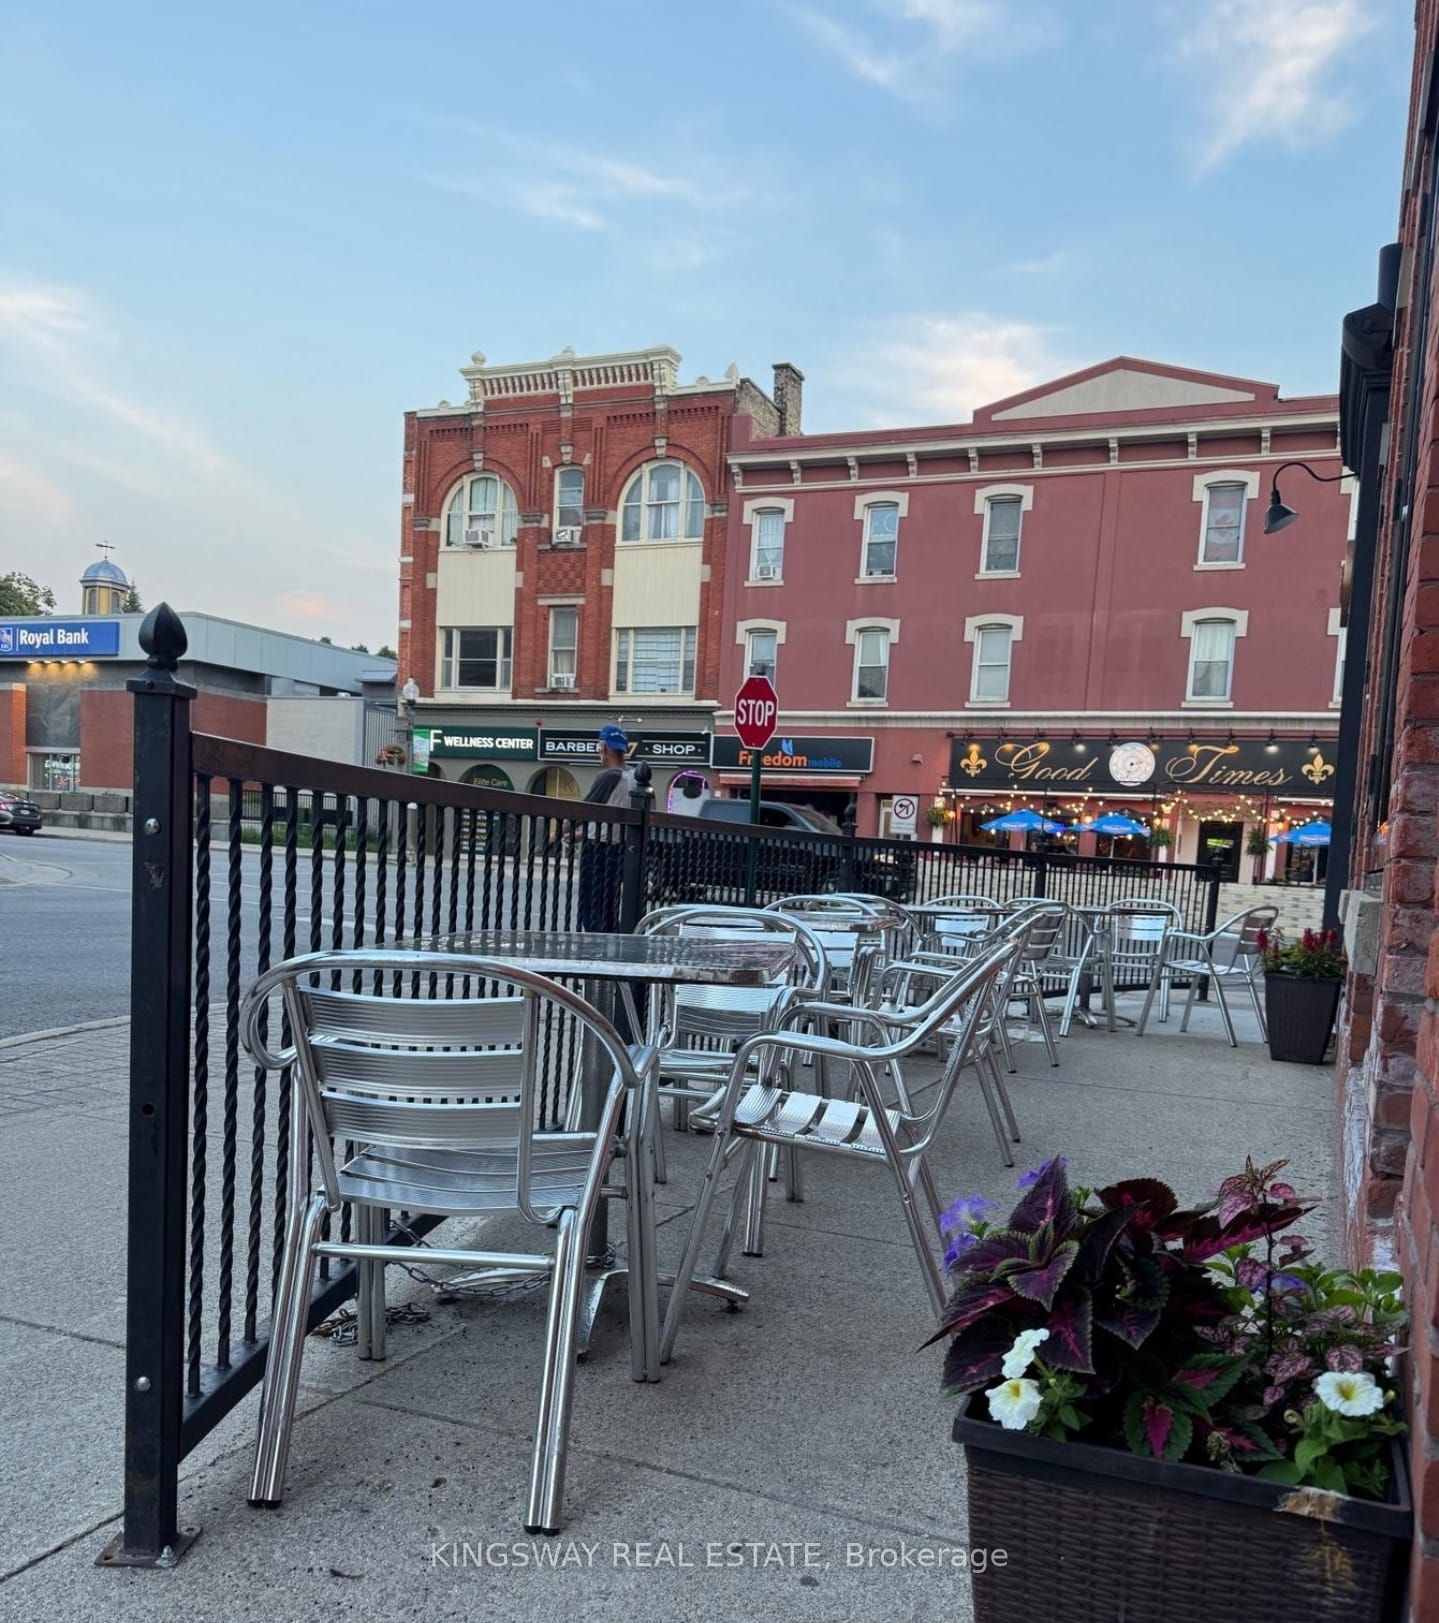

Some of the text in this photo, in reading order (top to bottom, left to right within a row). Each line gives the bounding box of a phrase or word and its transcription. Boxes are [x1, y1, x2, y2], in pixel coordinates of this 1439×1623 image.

[20, 628, 89, 649] Royal Bank
[737, 698, 775, 727] STOP
[443, 736, 494, 748] WELLNESS
[495, 738, 534, 750] CENTER
[652, 744, 696, 755] SHOP
[738, 750, 842, 768] Fredom mobile
[994, 742, 1293, 786] Good Times
